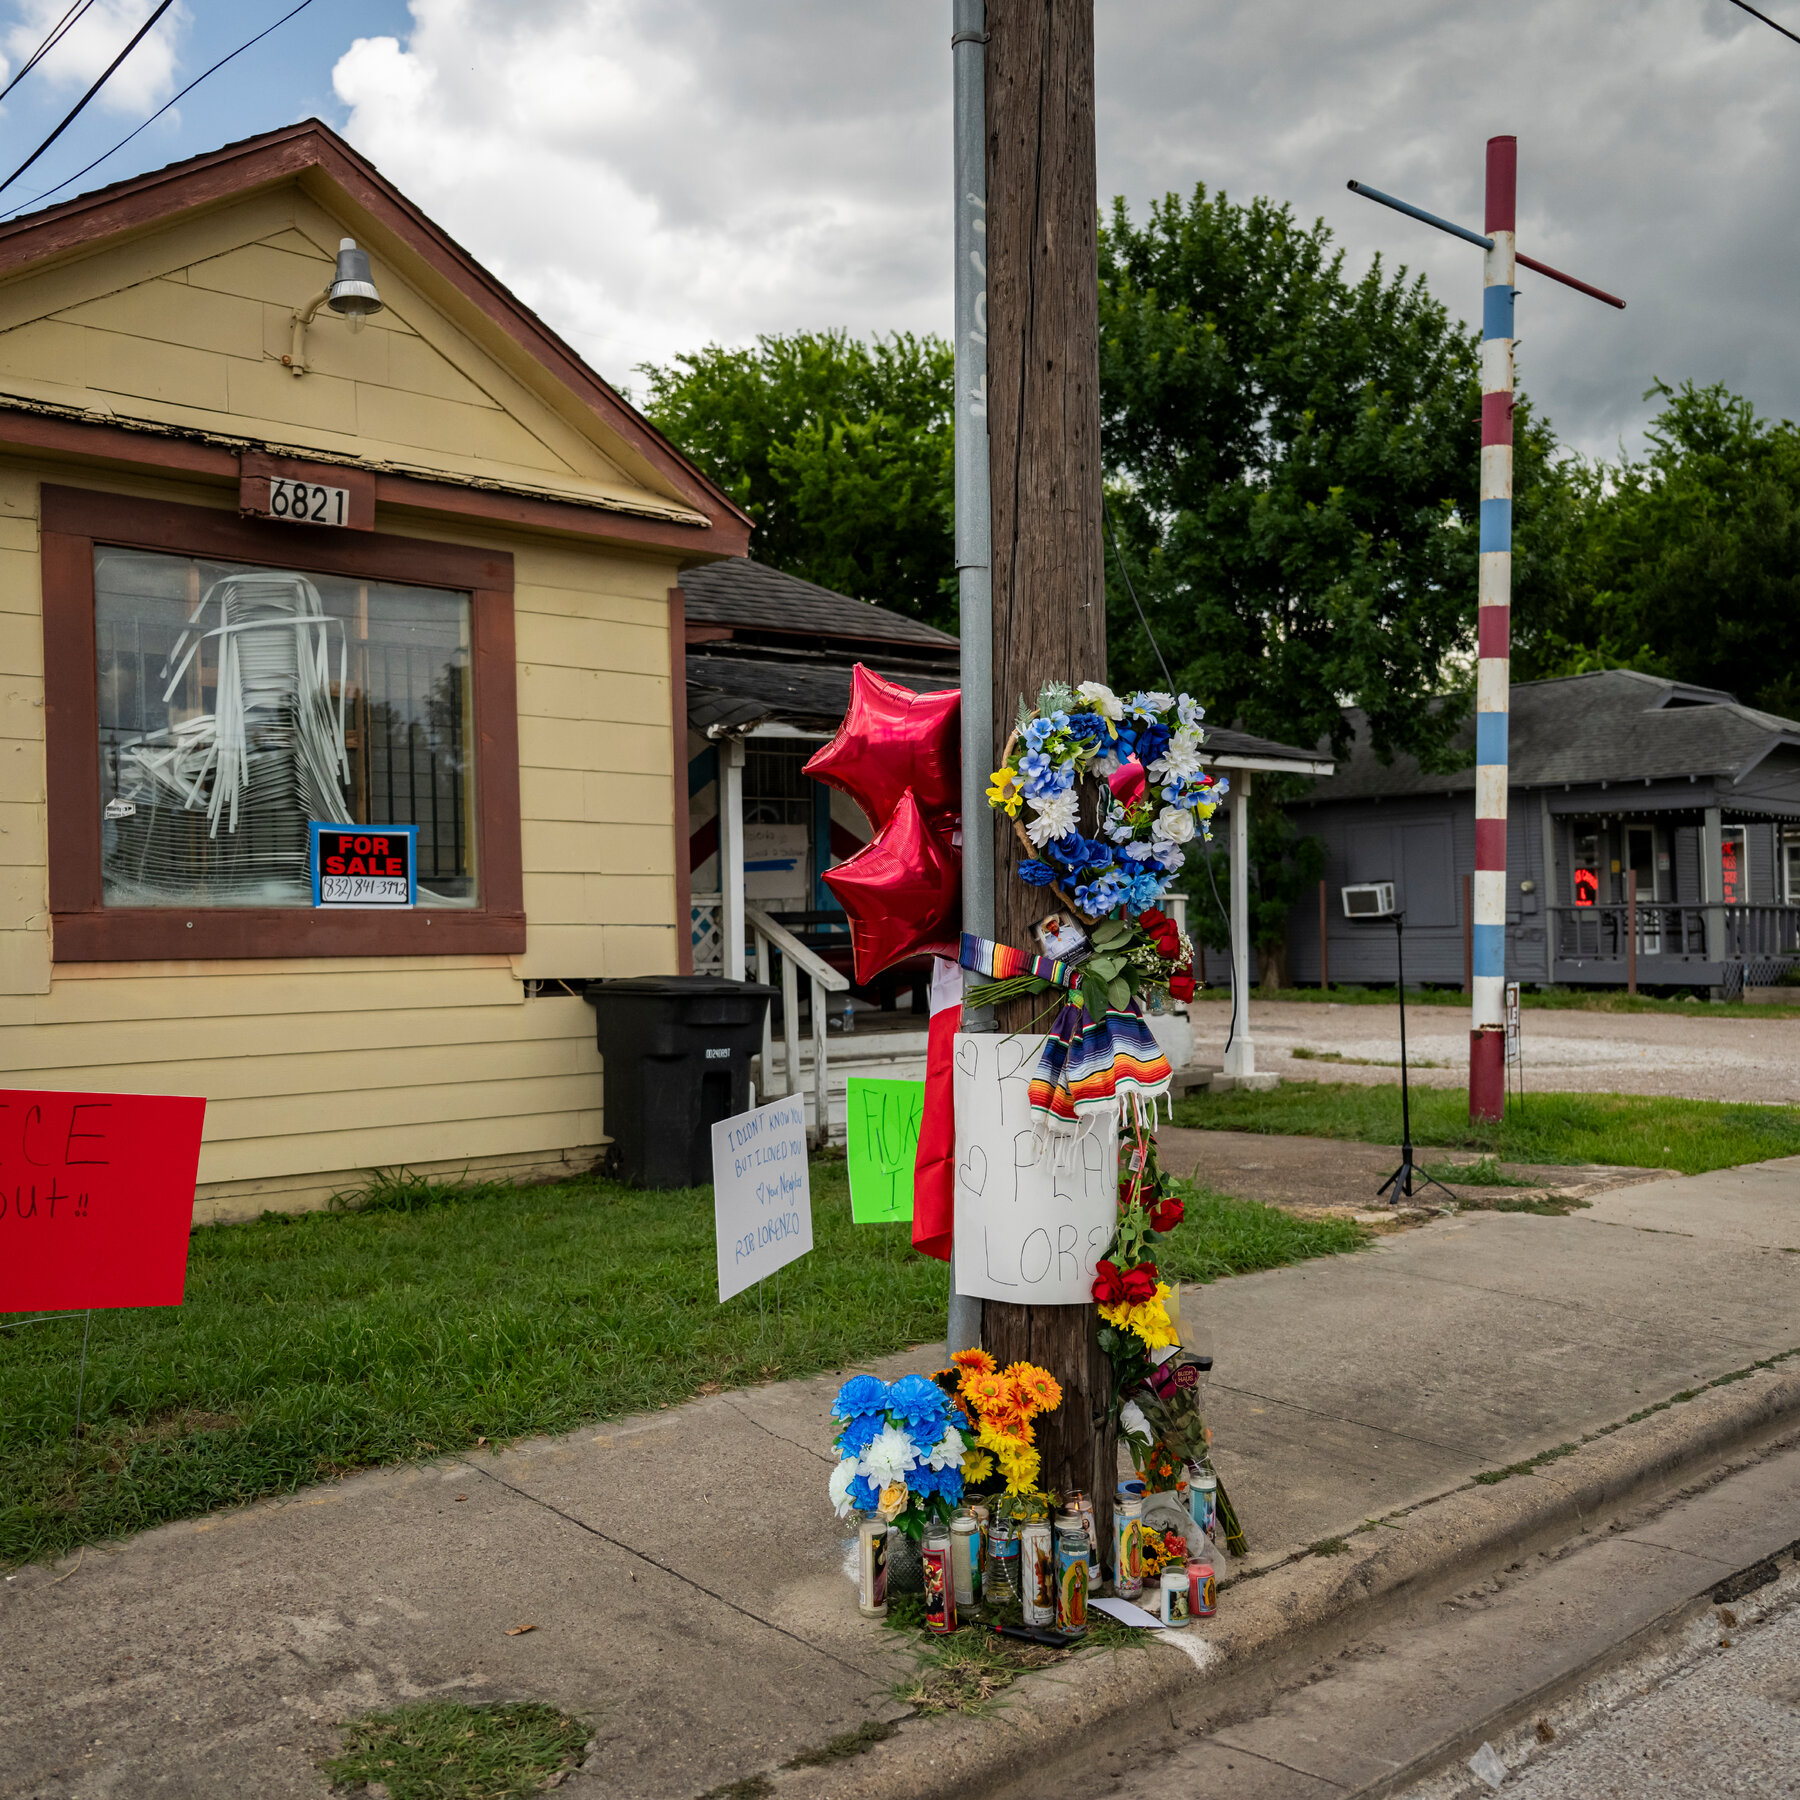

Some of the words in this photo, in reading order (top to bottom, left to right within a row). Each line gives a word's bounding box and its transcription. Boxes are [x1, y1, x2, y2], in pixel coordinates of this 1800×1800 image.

[271, 480, 344, 525] 6821
[338, 835, 390, 856] FOR
[325, 855, 403, 876] SALE
[0, 1103, 112, 1166] CE
[727, 1131, 736, 1153] I
[735, 1112, 765, 1147] DIDN'T
[768, 1111, 790, 1132] KNOW
[789, 1106, 803, 1125] YOU
[734, 1153, 752, 1178] BUT
[755, 1149, 762, 1167] I
[763, 1140, 787, 1163] LOVED
[788, 1140, 802, 1156] YOU
[766, 1183, 779, 1205] Your
[757, 1211, 800, 1248] LORENZO
[984, 1223, 1112, 1287] LORE
